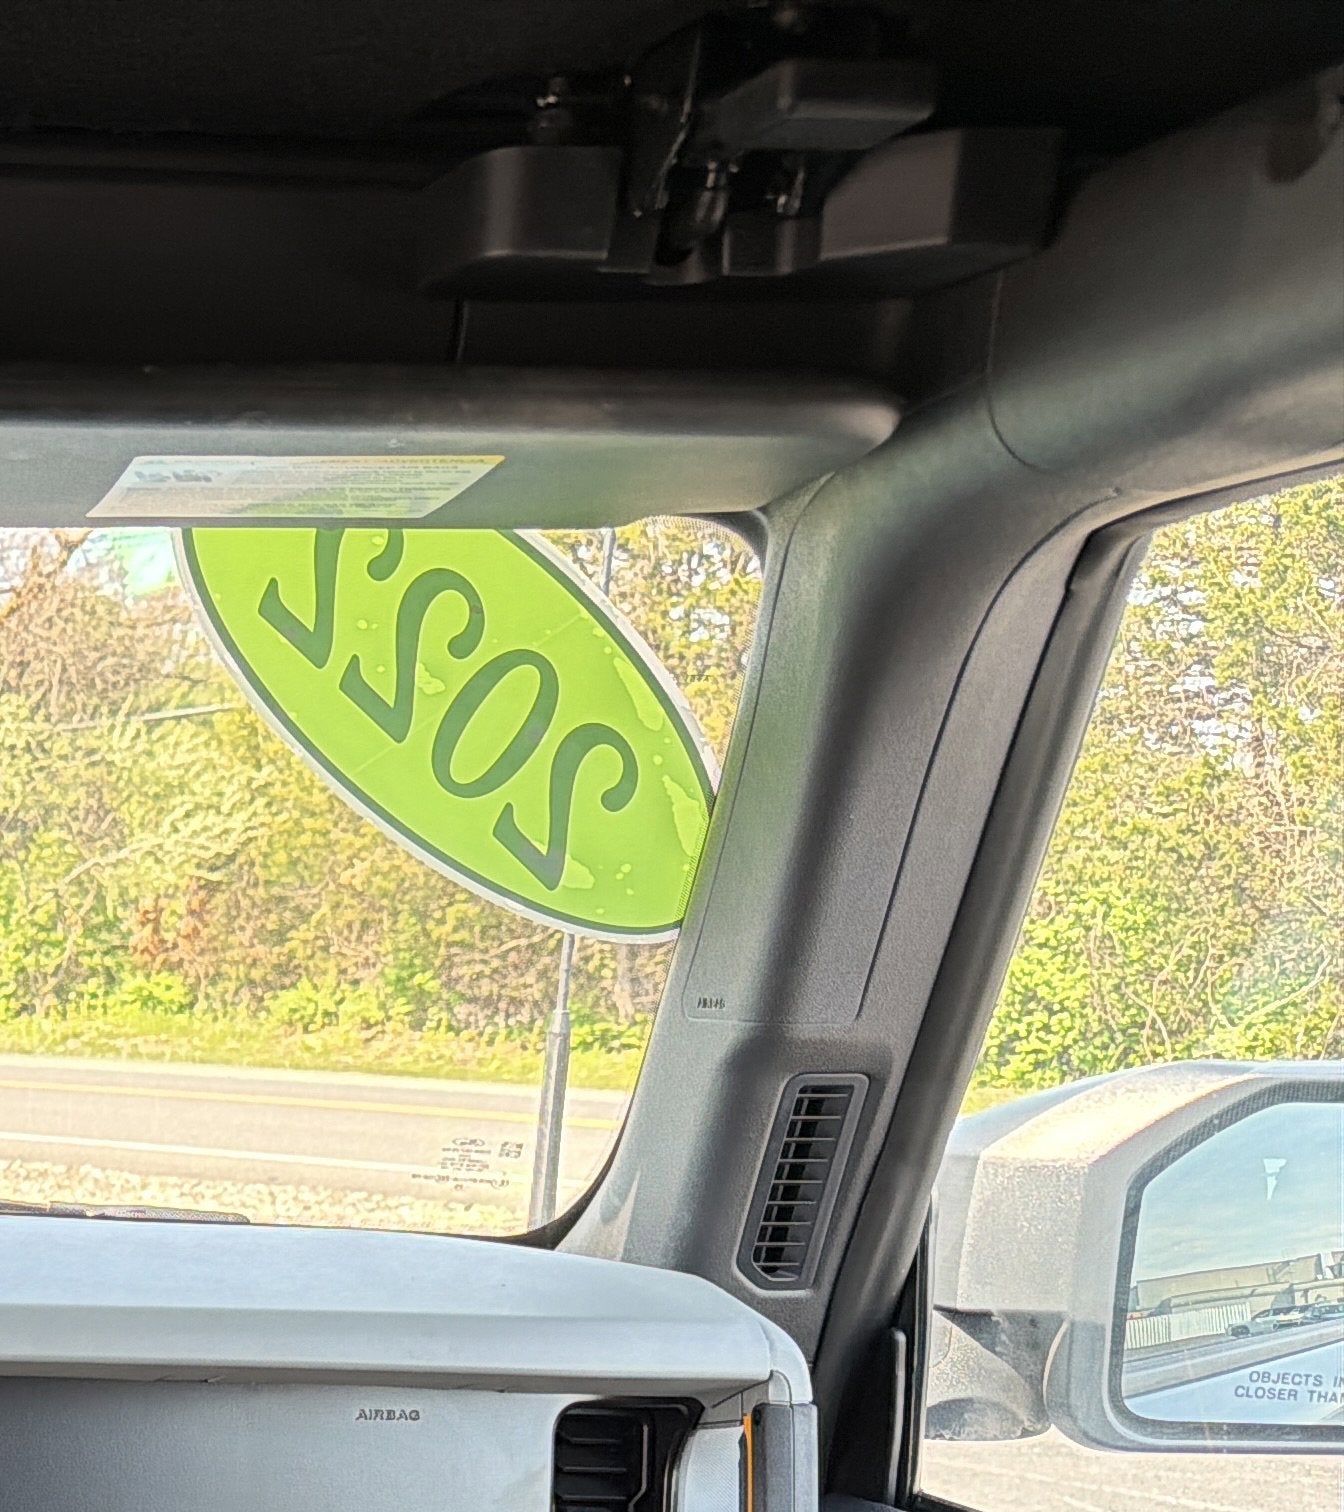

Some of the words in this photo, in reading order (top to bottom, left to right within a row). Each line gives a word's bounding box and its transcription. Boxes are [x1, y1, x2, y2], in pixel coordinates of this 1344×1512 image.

[1249, 1371, 1323, 1387] OBJECTS
[1234, 1385, 1299, 1401] CLOSER
[355, 1408, 421, 1422] AIRBAG
